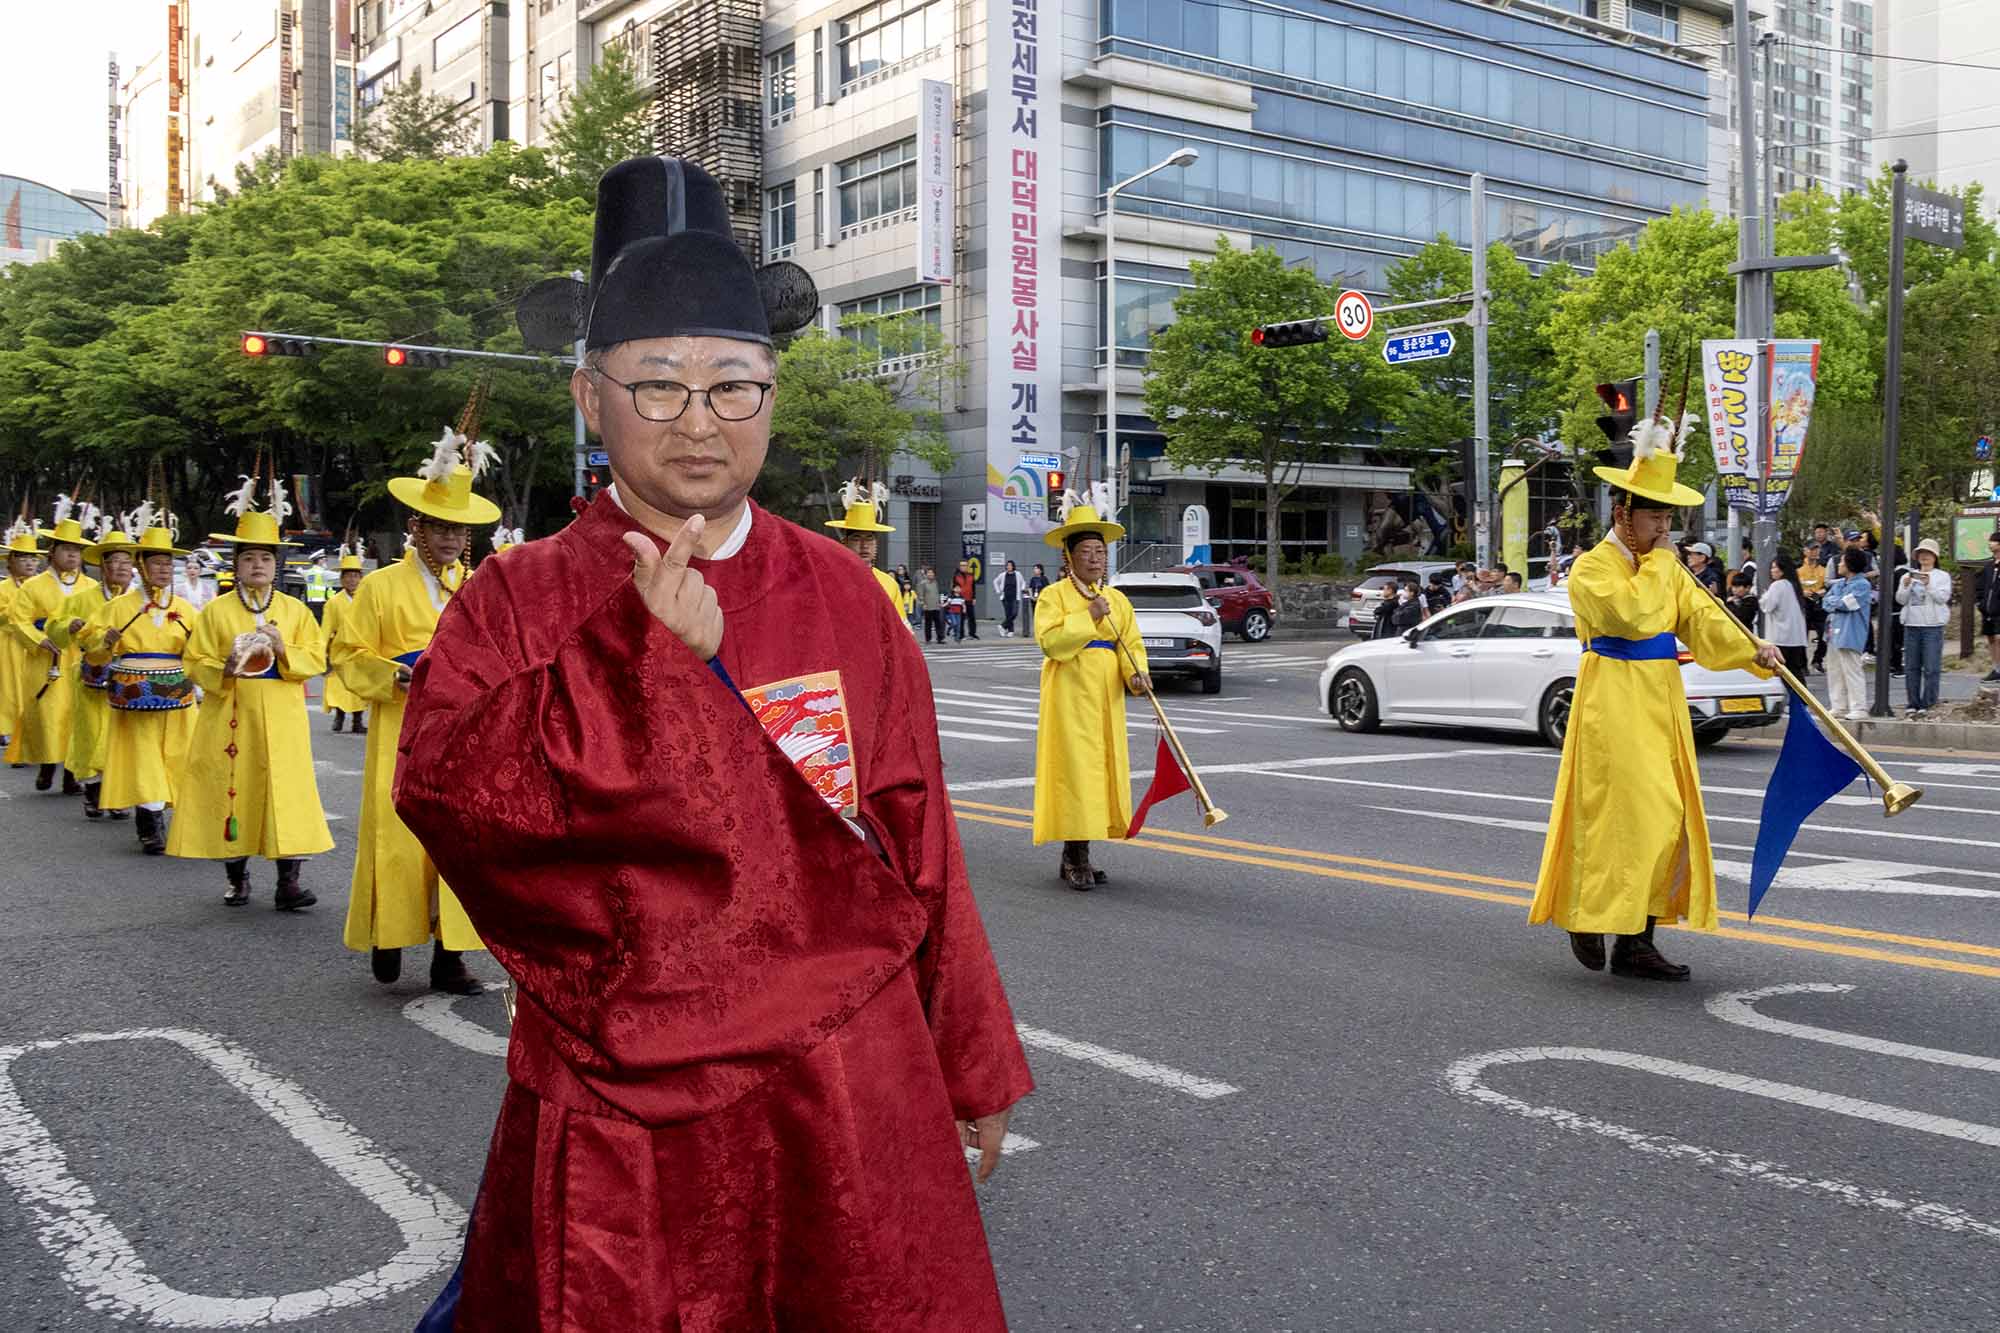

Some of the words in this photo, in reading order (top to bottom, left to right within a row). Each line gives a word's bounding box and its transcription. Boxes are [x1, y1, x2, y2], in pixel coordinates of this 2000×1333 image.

[1012, 149, 1039, 372] 대덕민원봉사실
[1343, 304, 1365, 327] 30
[1402, 335, 1434, 351] 동춘당로
[1011, 382, 1037, 444] 개소
[1716, 350, 1752, 470] 뽀로로
[1003, 500, 1044, 517] 대덕구
